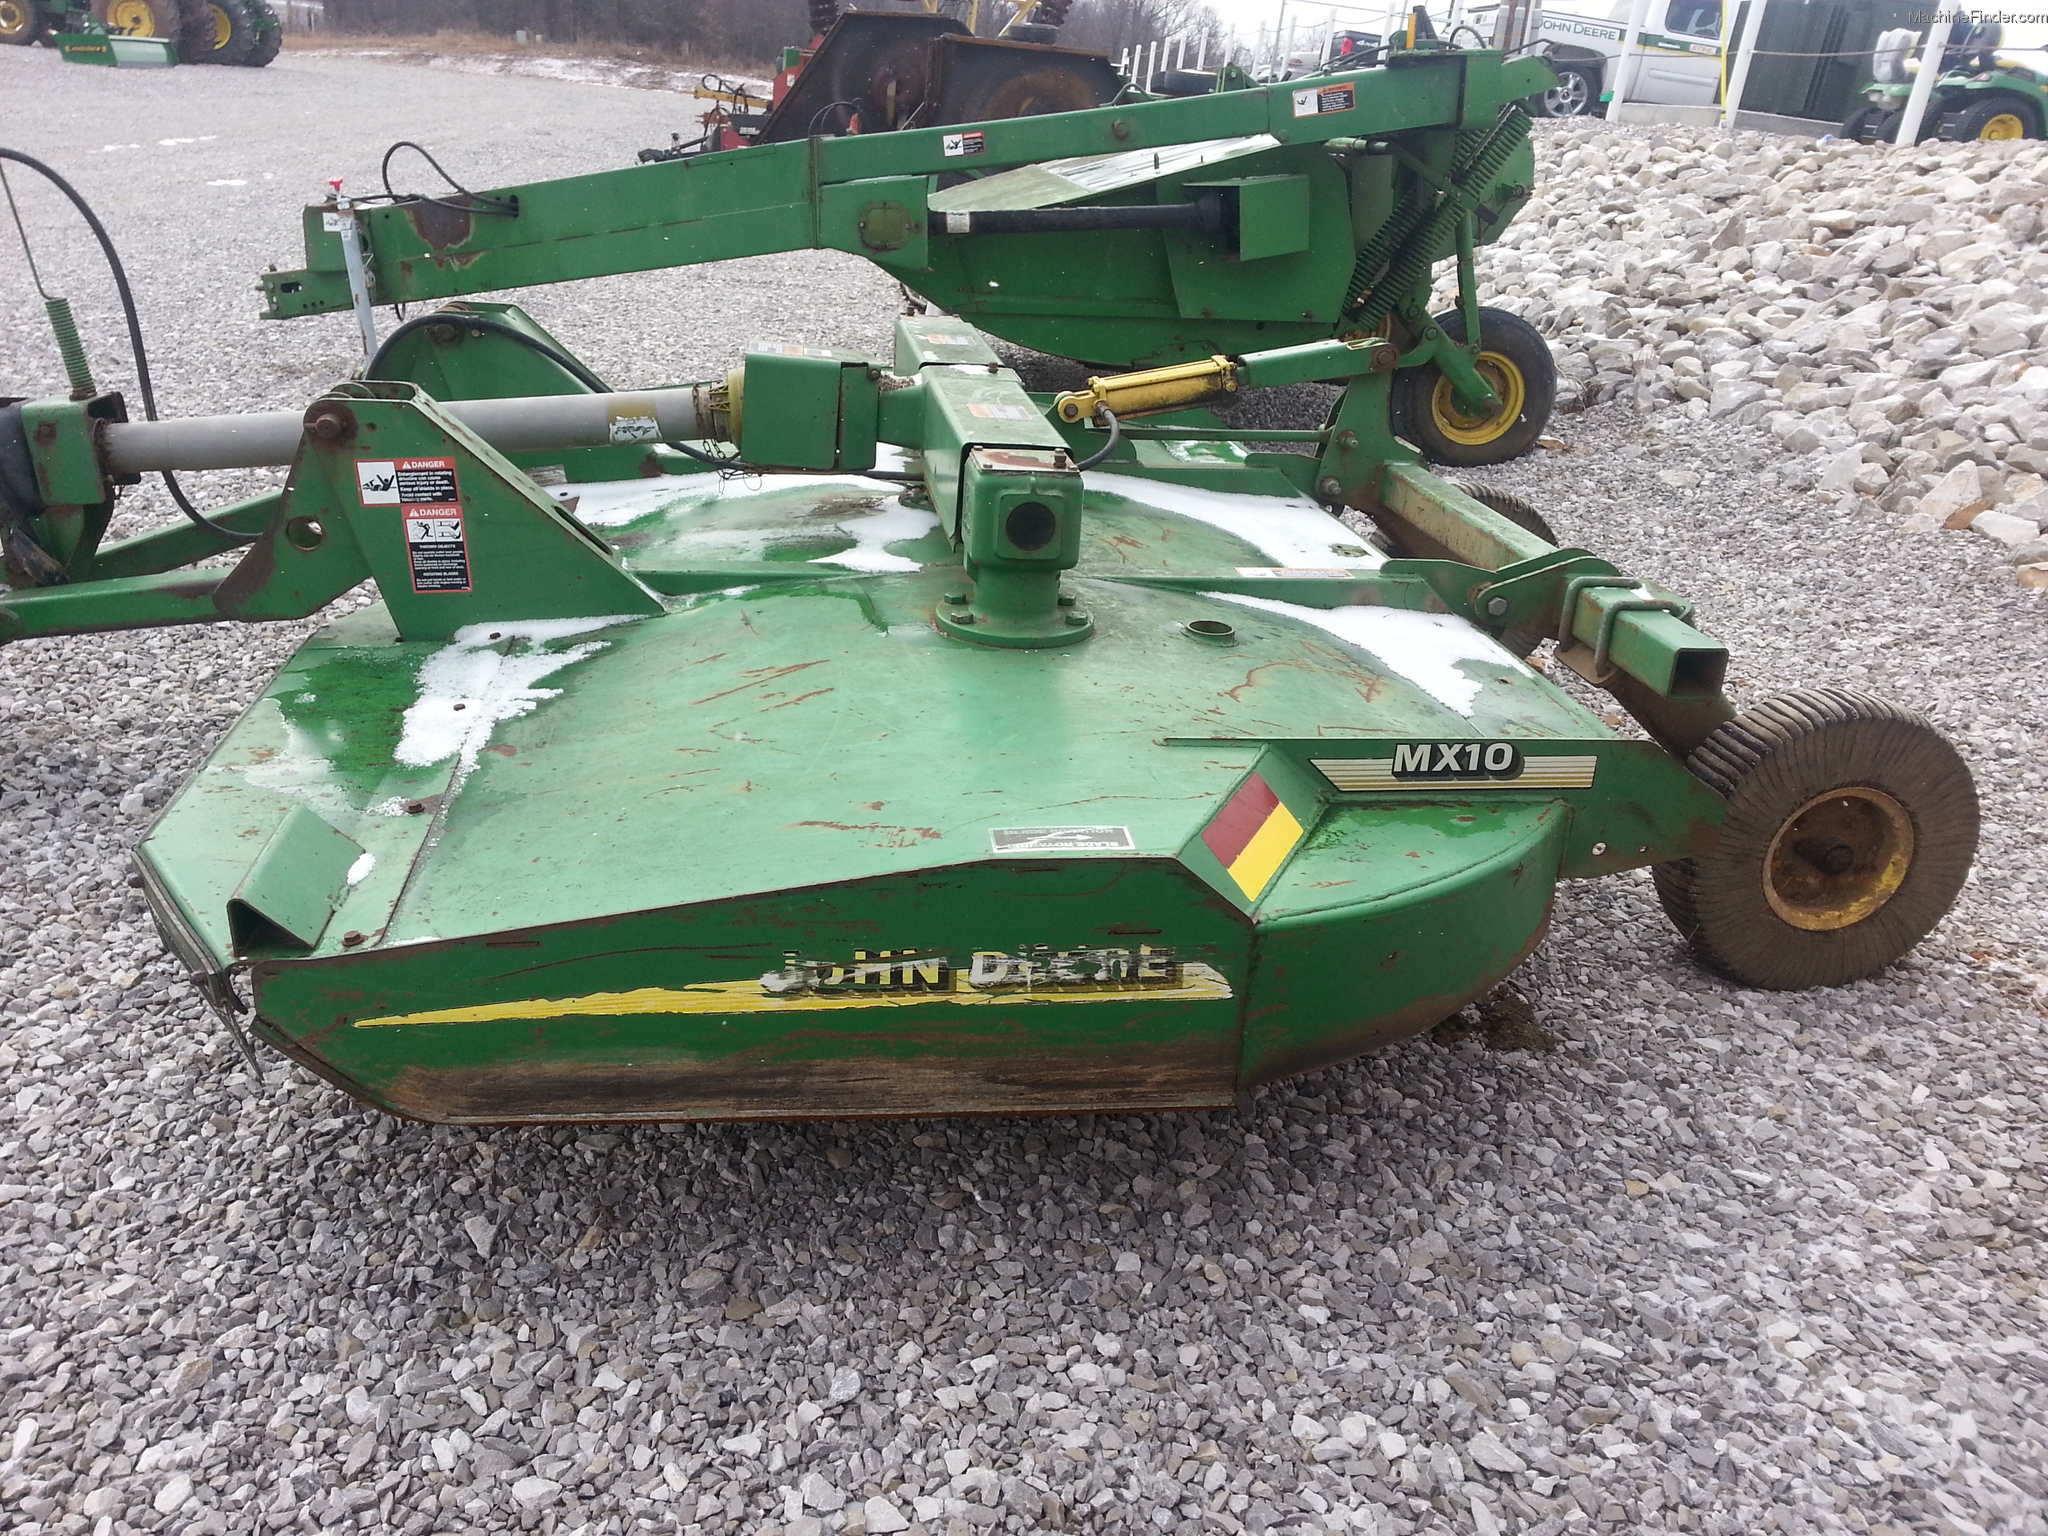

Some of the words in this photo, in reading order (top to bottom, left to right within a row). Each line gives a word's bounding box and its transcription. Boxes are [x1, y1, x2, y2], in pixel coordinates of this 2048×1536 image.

[1573, 23, 1617, 41] DEERE
[411, 460, 445, 468] DANGER
[420, 508, 457, 516] DANGER
[1393, 742, 1516, 775] MX10
[969, 943, 1179, 988] DRE
